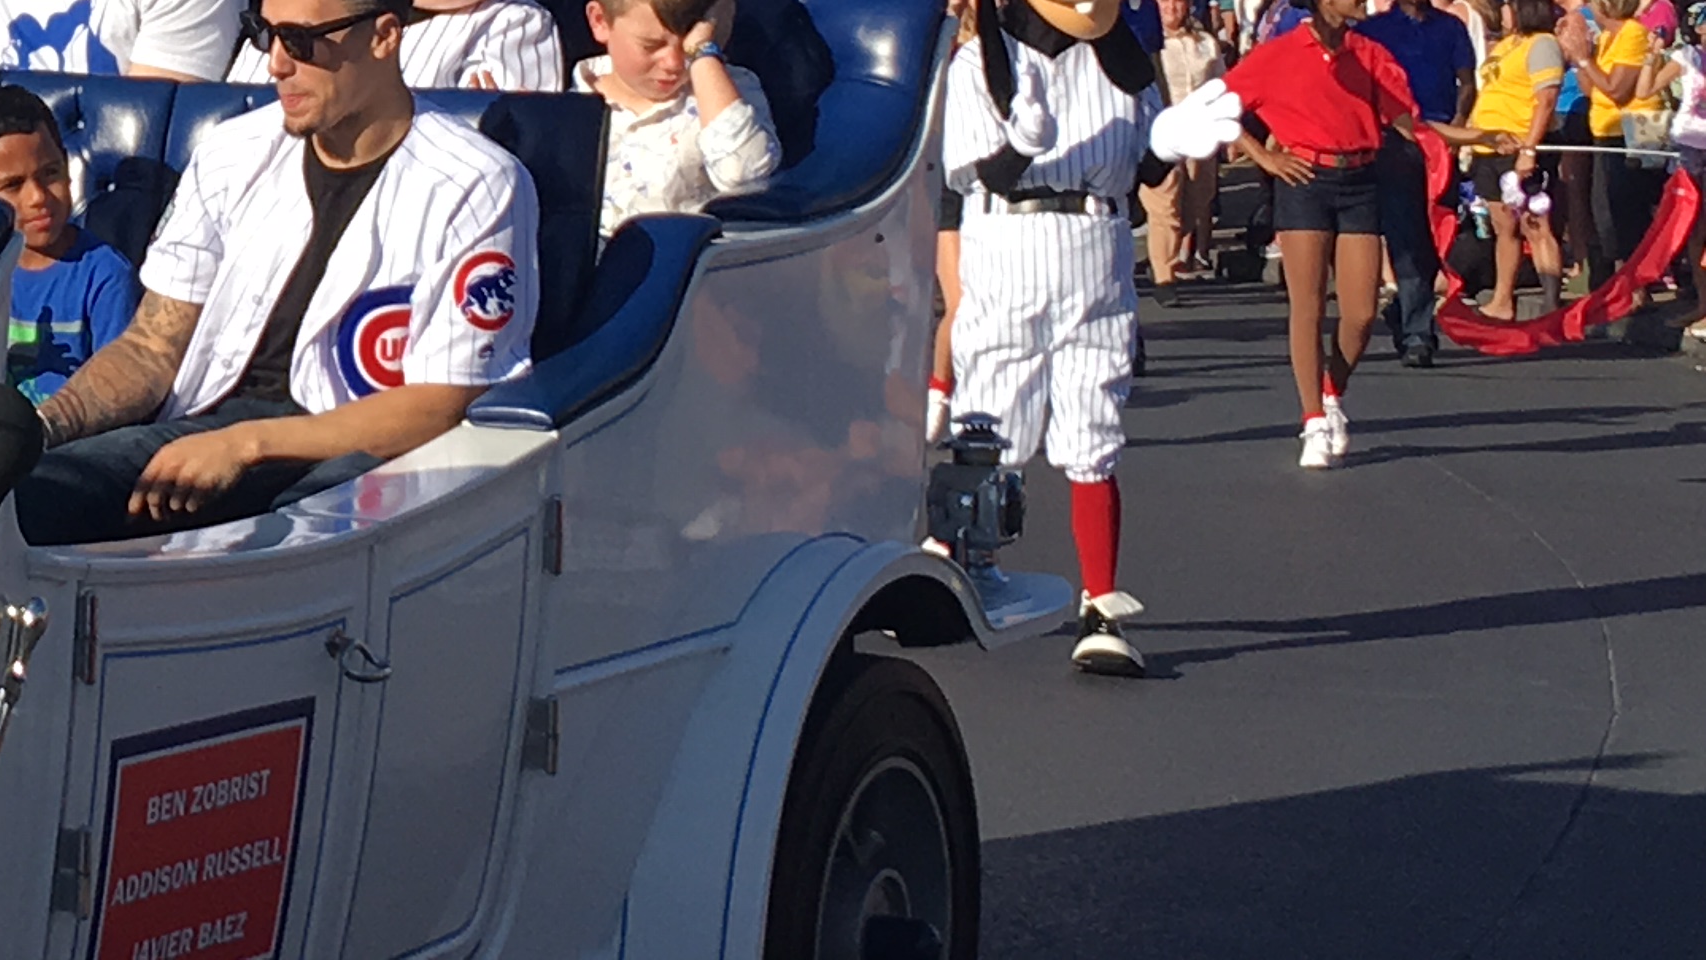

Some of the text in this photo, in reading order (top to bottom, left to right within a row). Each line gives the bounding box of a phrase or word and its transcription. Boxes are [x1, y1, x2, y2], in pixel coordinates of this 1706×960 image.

[146, 768, 271, 825] BEN ZOBRIST
[110, 836, 282, 907] ADDISON RUSSELL
[197, 911, 248, 950] BAEZ
